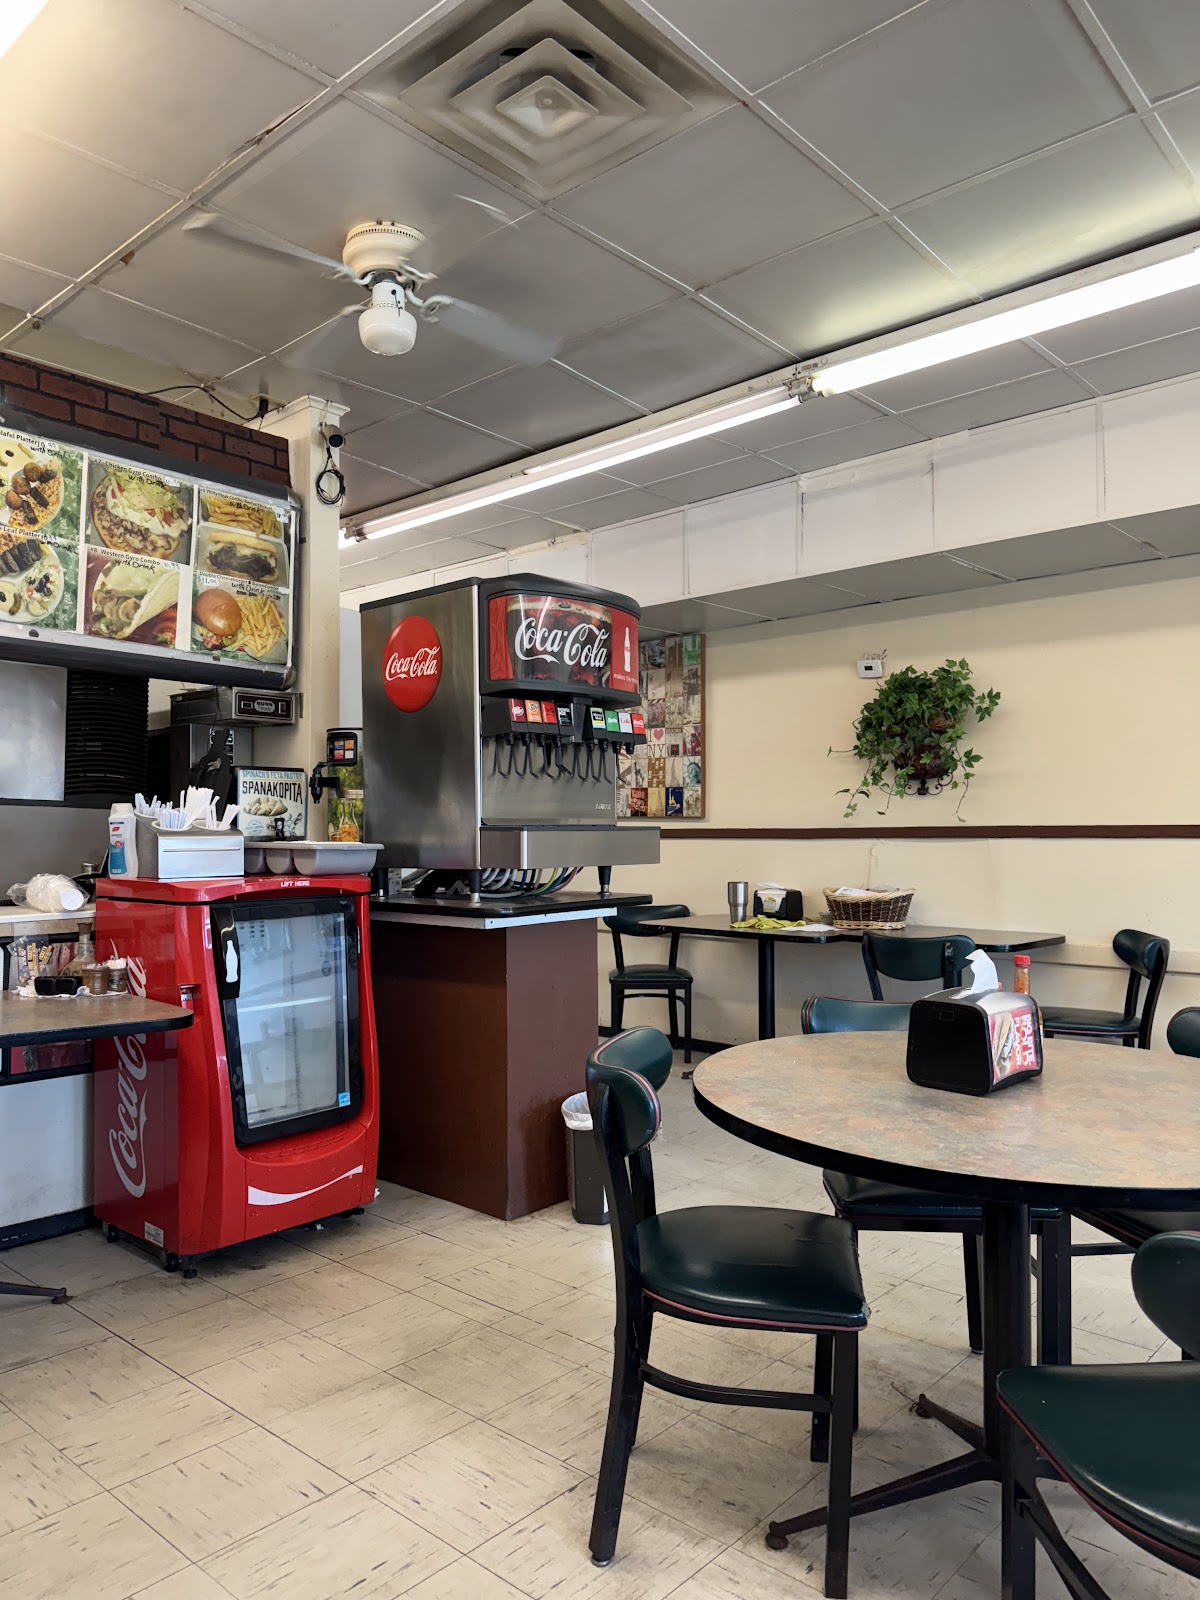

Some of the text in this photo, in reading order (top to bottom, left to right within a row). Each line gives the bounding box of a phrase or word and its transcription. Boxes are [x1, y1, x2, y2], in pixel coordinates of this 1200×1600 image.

[0, 430, 37, 445] lafel Platter
[105, 461, 128, 472] Chicken
[142, 471, 162, 481] Combo
[19, 529, 40, 539] Platter
[101, 548, 124, 559] Western
[125, 553, 139, 563] Gyro
[140, 557, 161, 566] Combo
[132, 561, 156, 574] Drink
[246, 584, 264, 596] Drink
[515, 617, 610, 668] Coca-Cola
[385, 646, 440, 682] Coca-Cola
[613, 673, 625, 681] makes
[648, 728, 652, 742] I
[648, 744, 665, 758] NY
[242, 770, 266, 778] SPINACH
[242, 780, 303, 805] SPANAKOPITA
[1024, 1014, 1032, 1034] BIG
[1021, 1017, 1029, 1066] BOLD
